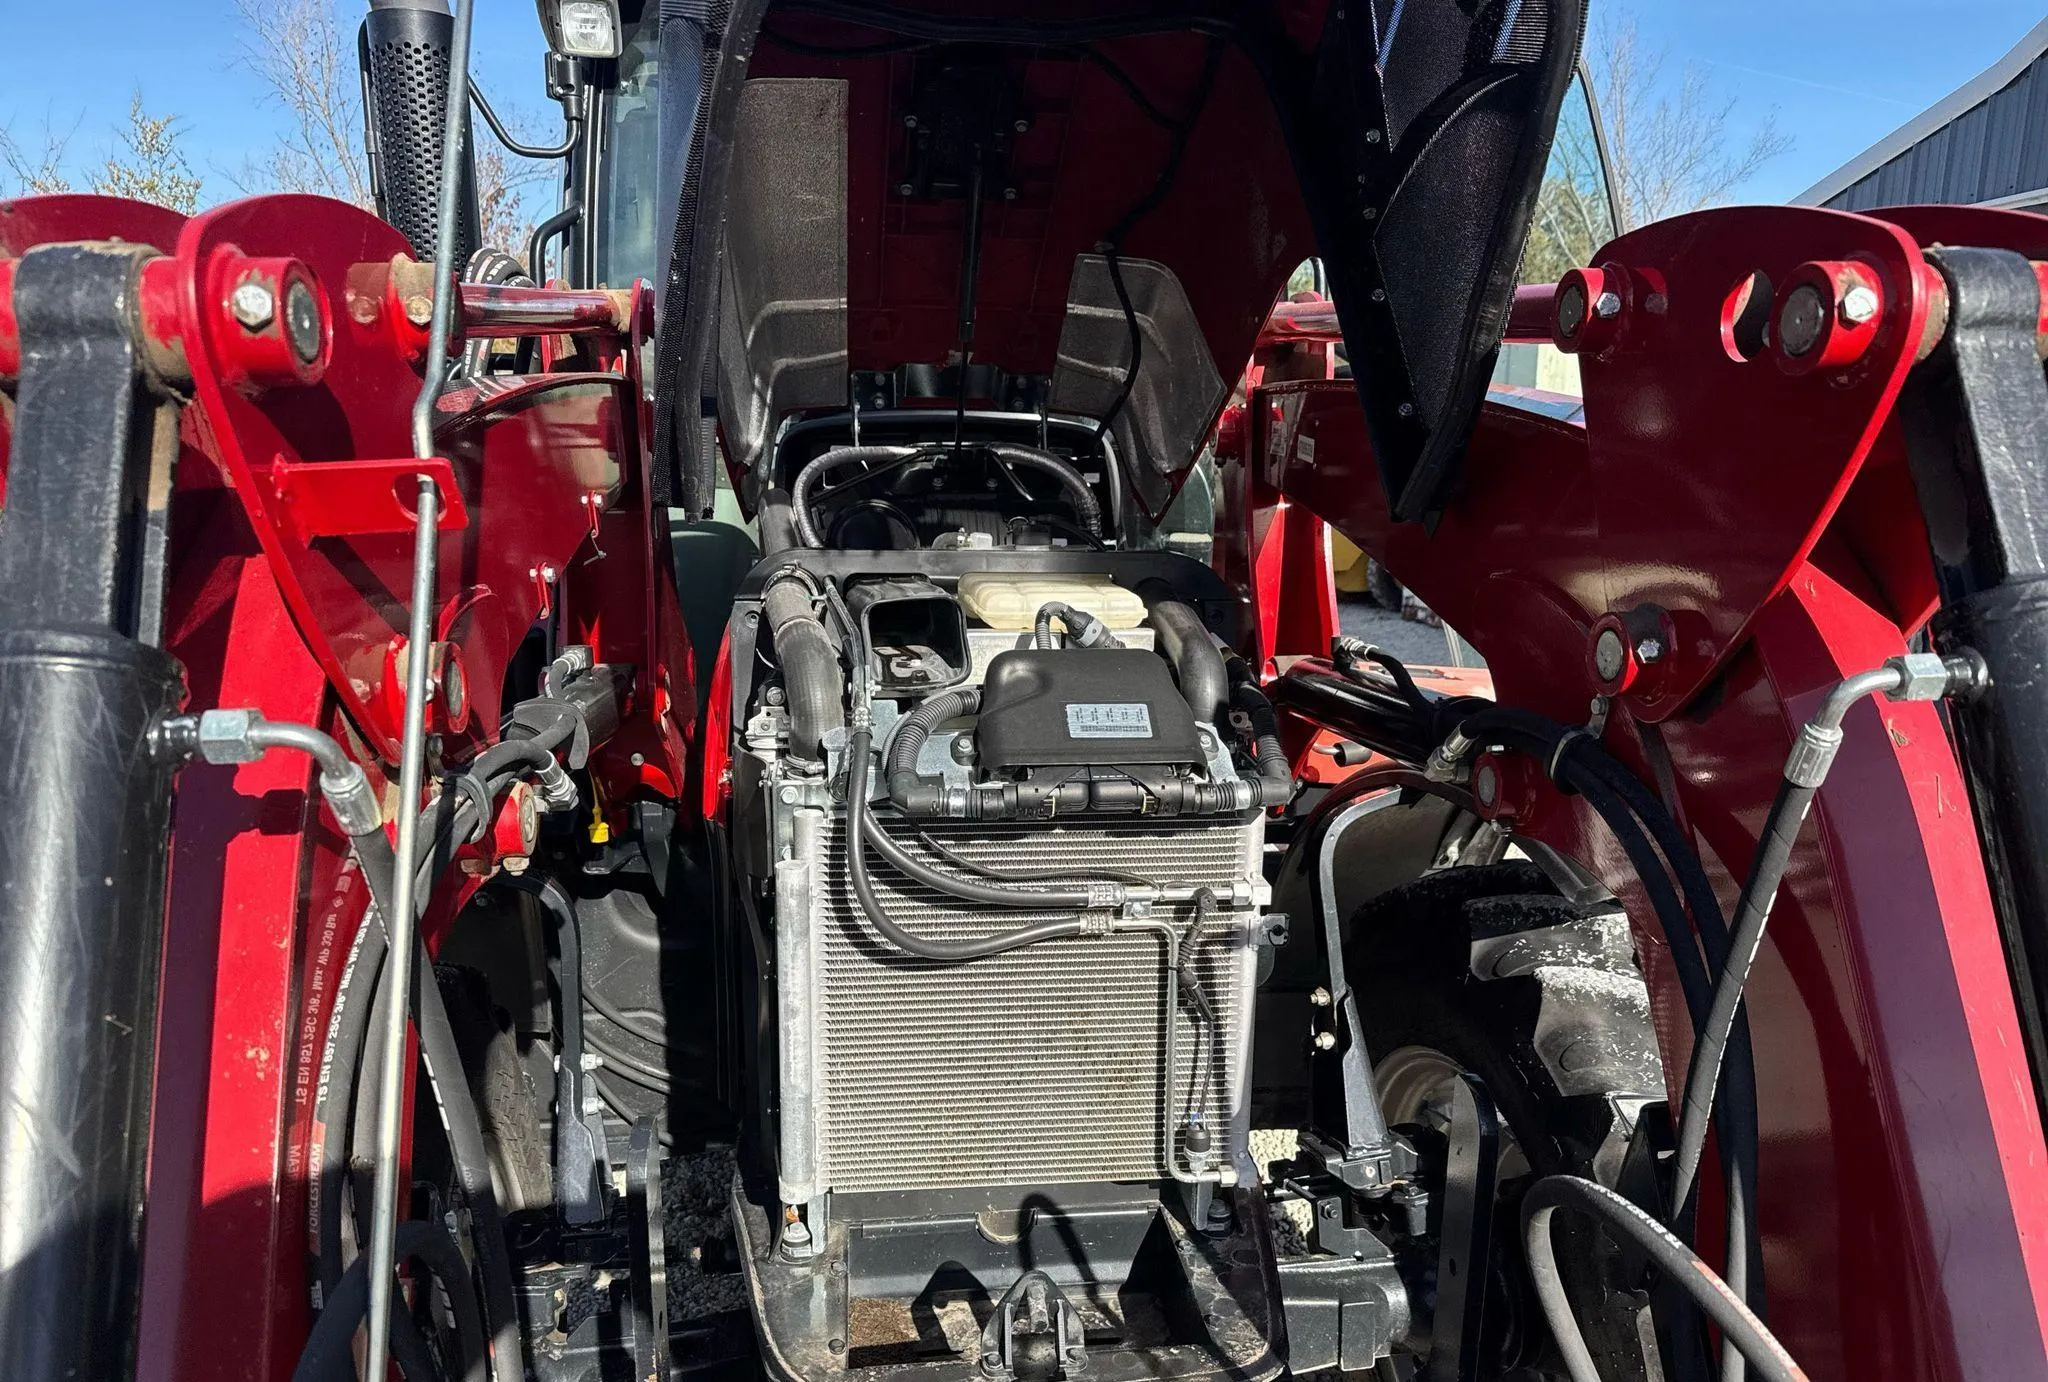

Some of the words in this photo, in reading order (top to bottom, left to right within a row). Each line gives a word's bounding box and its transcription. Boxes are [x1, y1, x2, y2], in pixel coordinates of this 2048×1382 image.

[353, 927, 367, 945] 330
[348, 946, 359, 964] WP
[340, 964, 355, 989] Max.
[328, 1014, 341, 1039] 2SC
[323, 1041, 336, 1063] 857
[320, 1064, 331, 1084] EN
[317, 1086, 328, 1105] TS
[309, 1143, 322, 1233] FORCESTREAM
